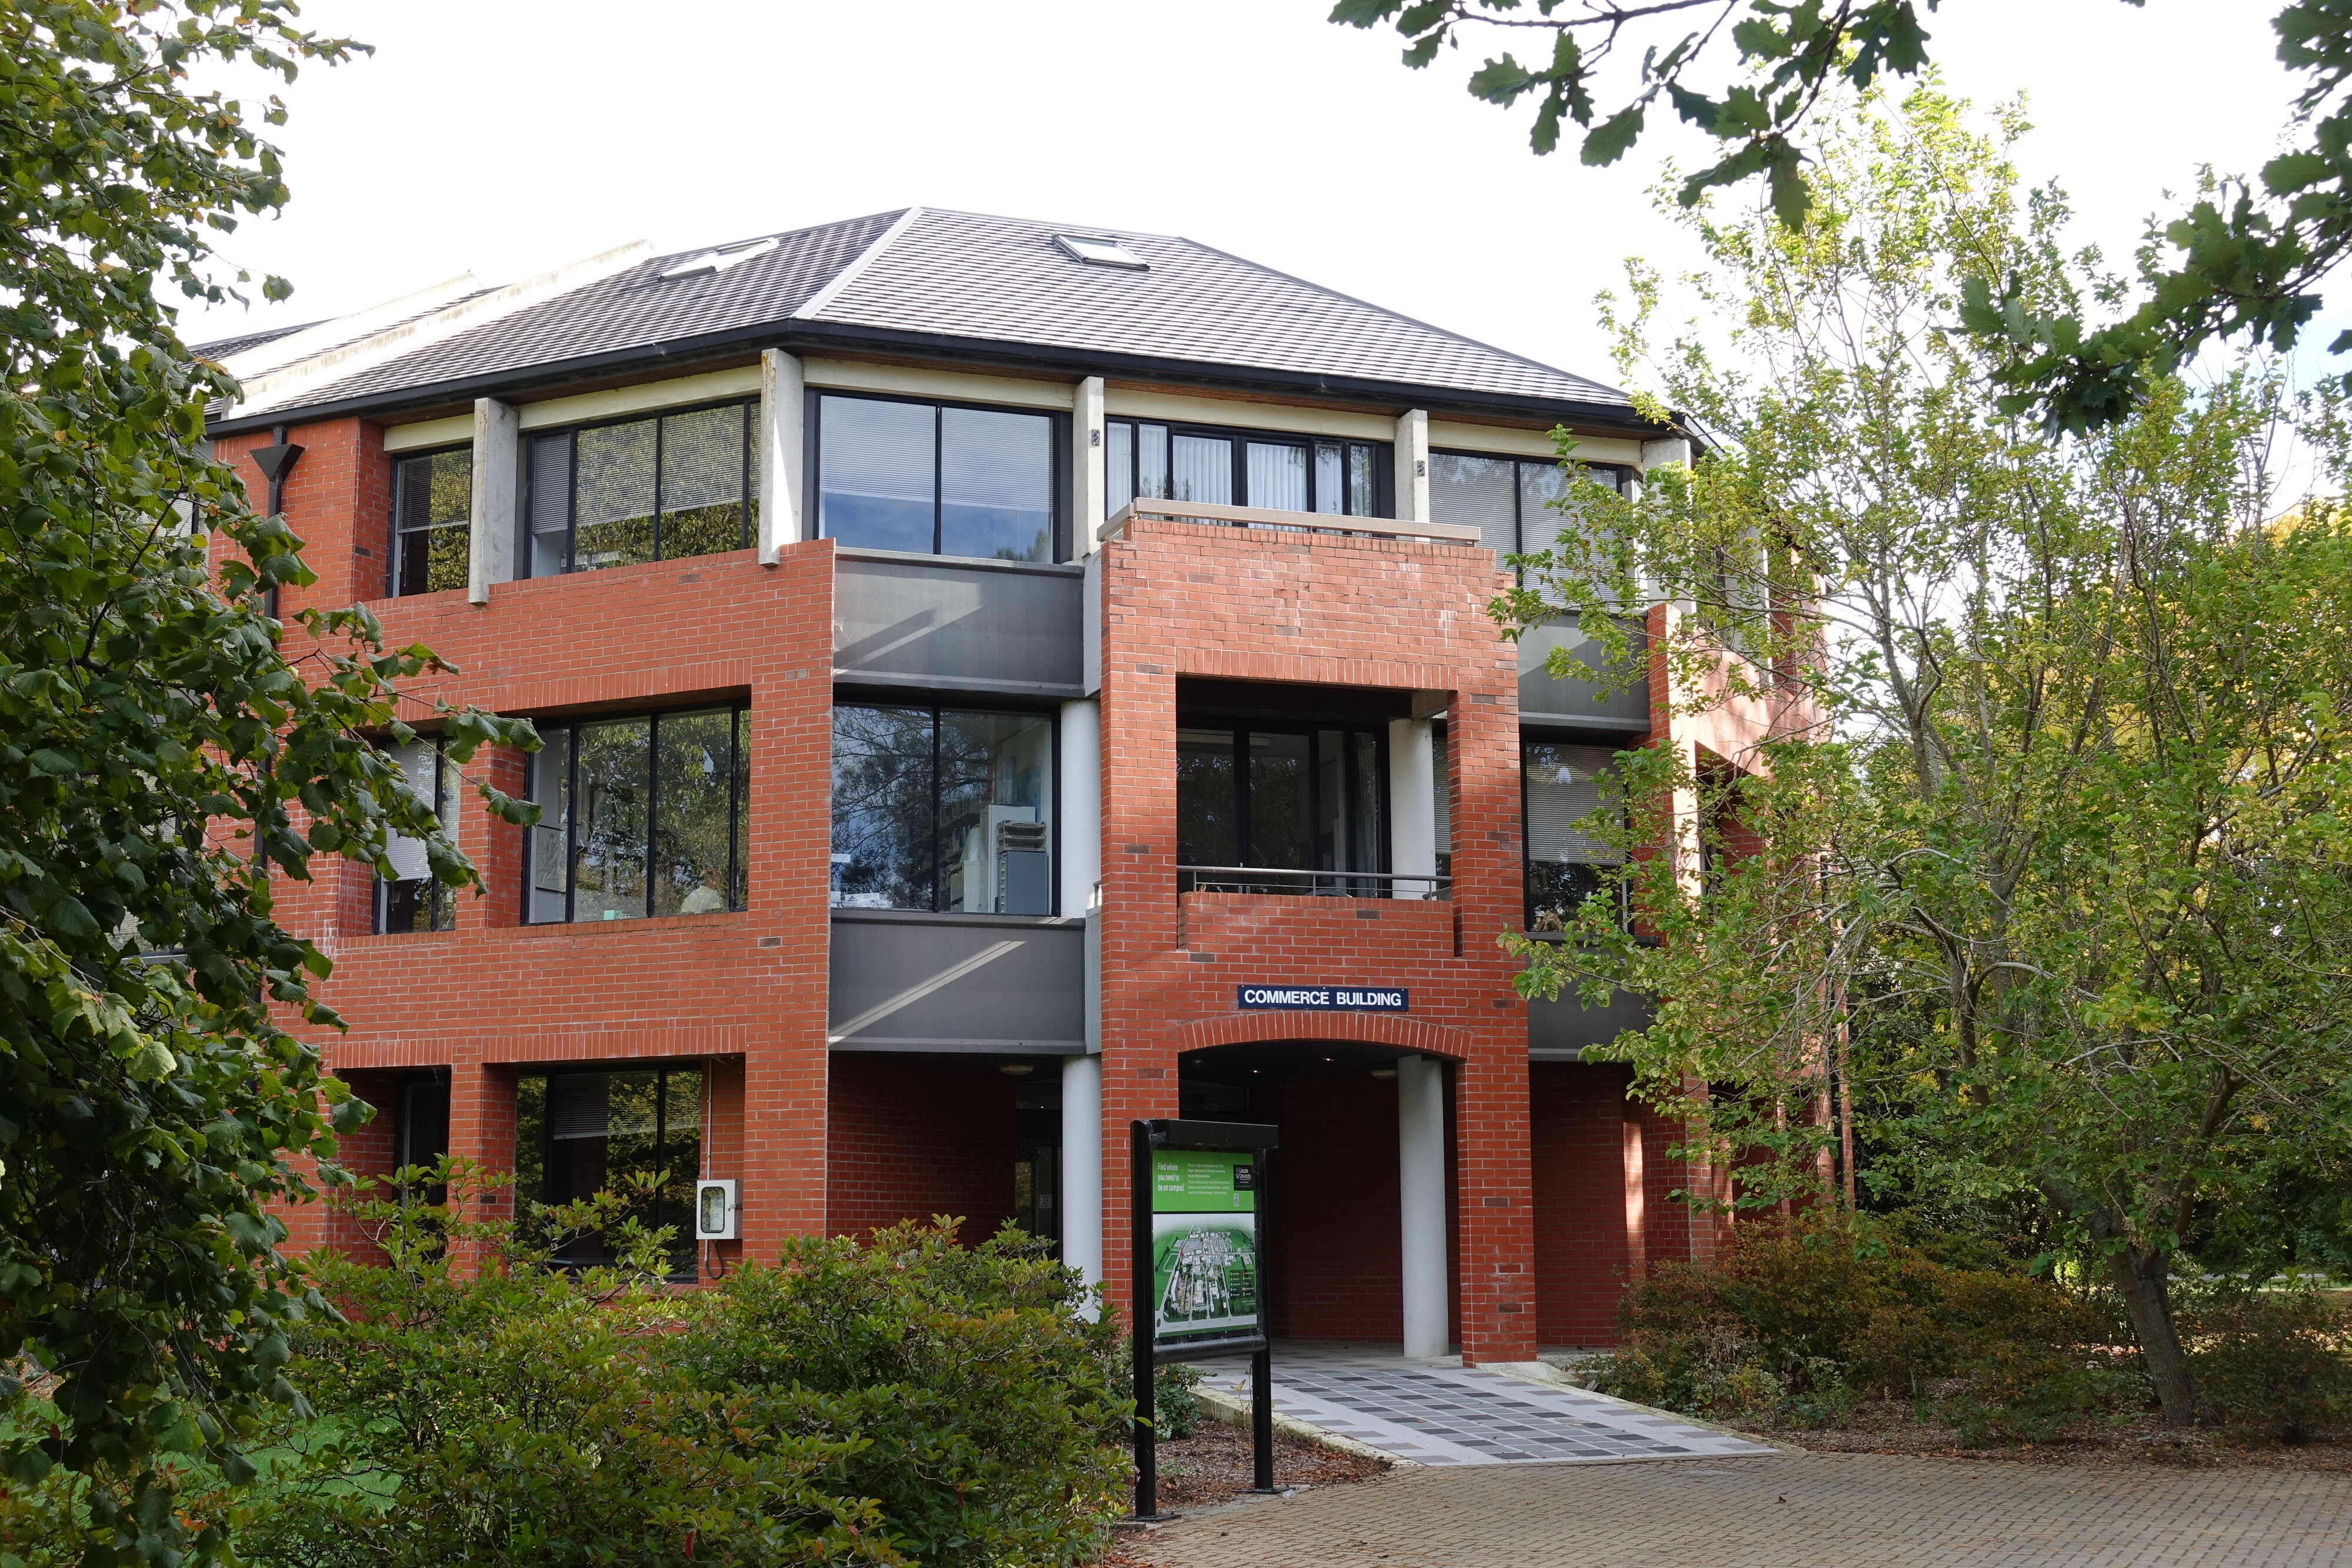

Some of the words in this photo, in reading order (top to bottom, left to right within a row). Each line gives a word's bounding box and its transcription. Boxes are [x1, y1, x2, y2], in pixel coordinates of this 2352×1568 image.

[1245, 989, 1329, 1005] COMMERCE
[1336, 992, 1401, 1006] BUILDING
[1157, 1162, 1166, 1170] Find
[1167, 1162, 1178, 1170] where
[1166, 1173, 1175, 1181] need
[1158, 1183, 1163, 1191] be
[1169, 1183, 1185, 1193] campus!
